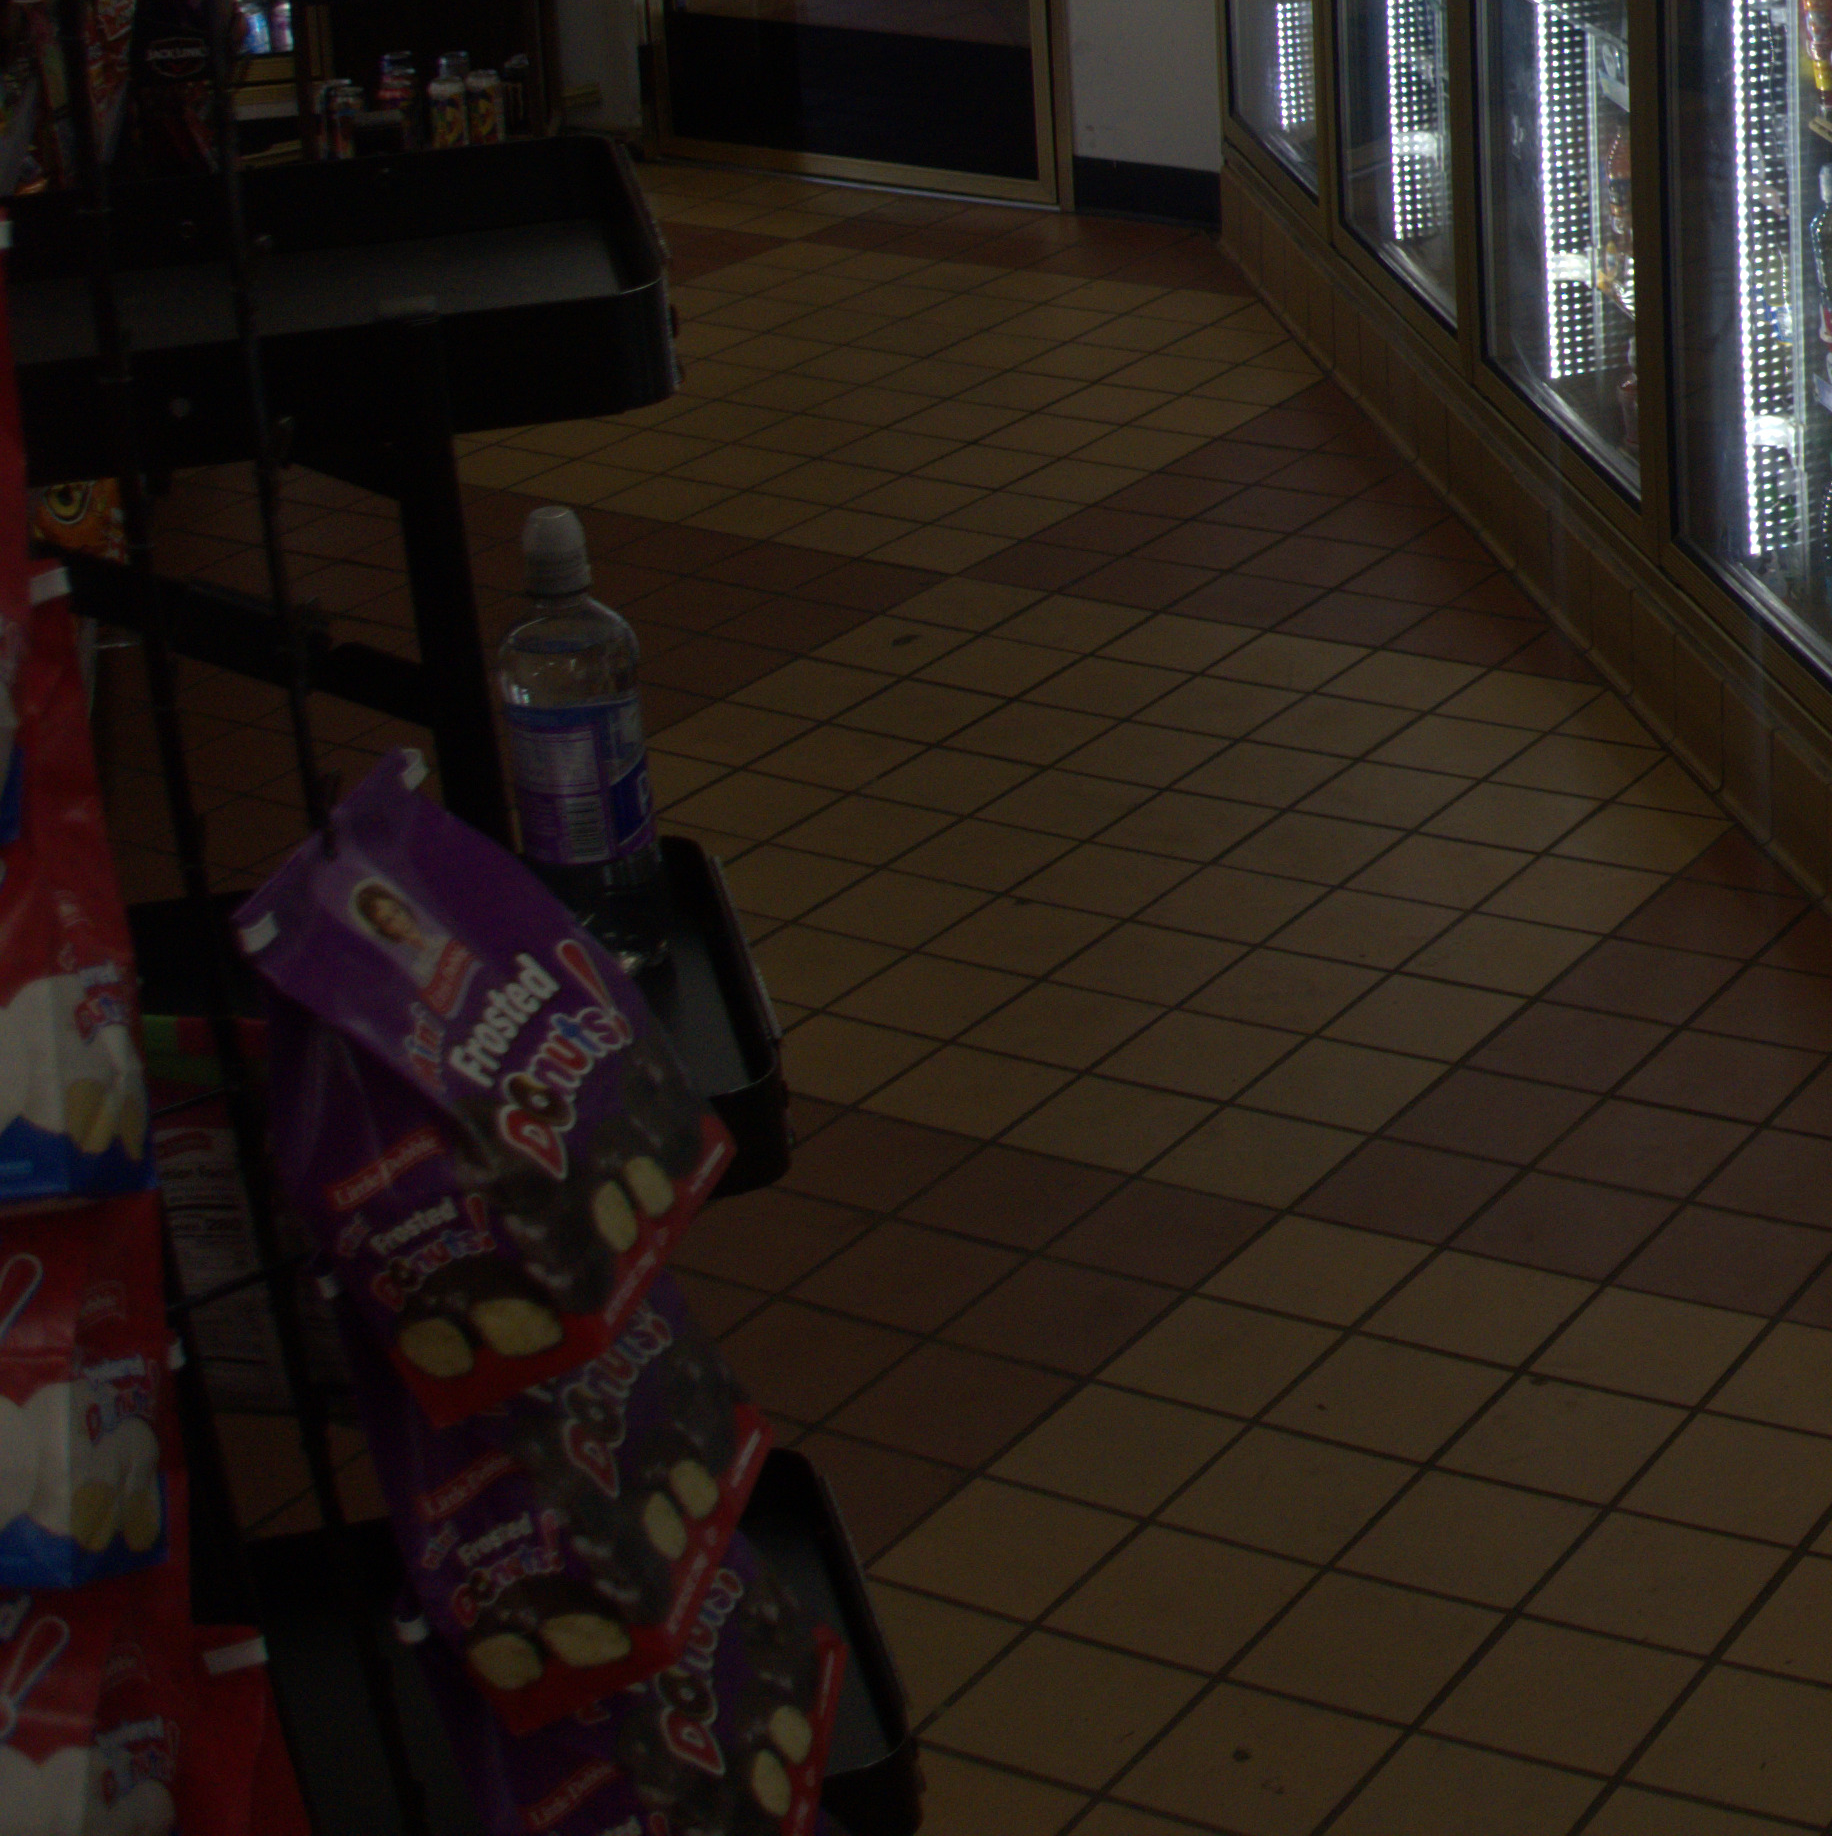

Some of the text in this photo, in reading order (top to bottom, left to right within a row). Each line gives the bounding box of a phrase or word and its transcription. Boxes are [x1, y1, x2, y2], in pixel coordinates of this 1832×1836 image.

[449, 953, 560, 1088] Frosted
[370, 1195, 459, 1256] Frosted
[457, 1510, 535, 1566] Frosted
